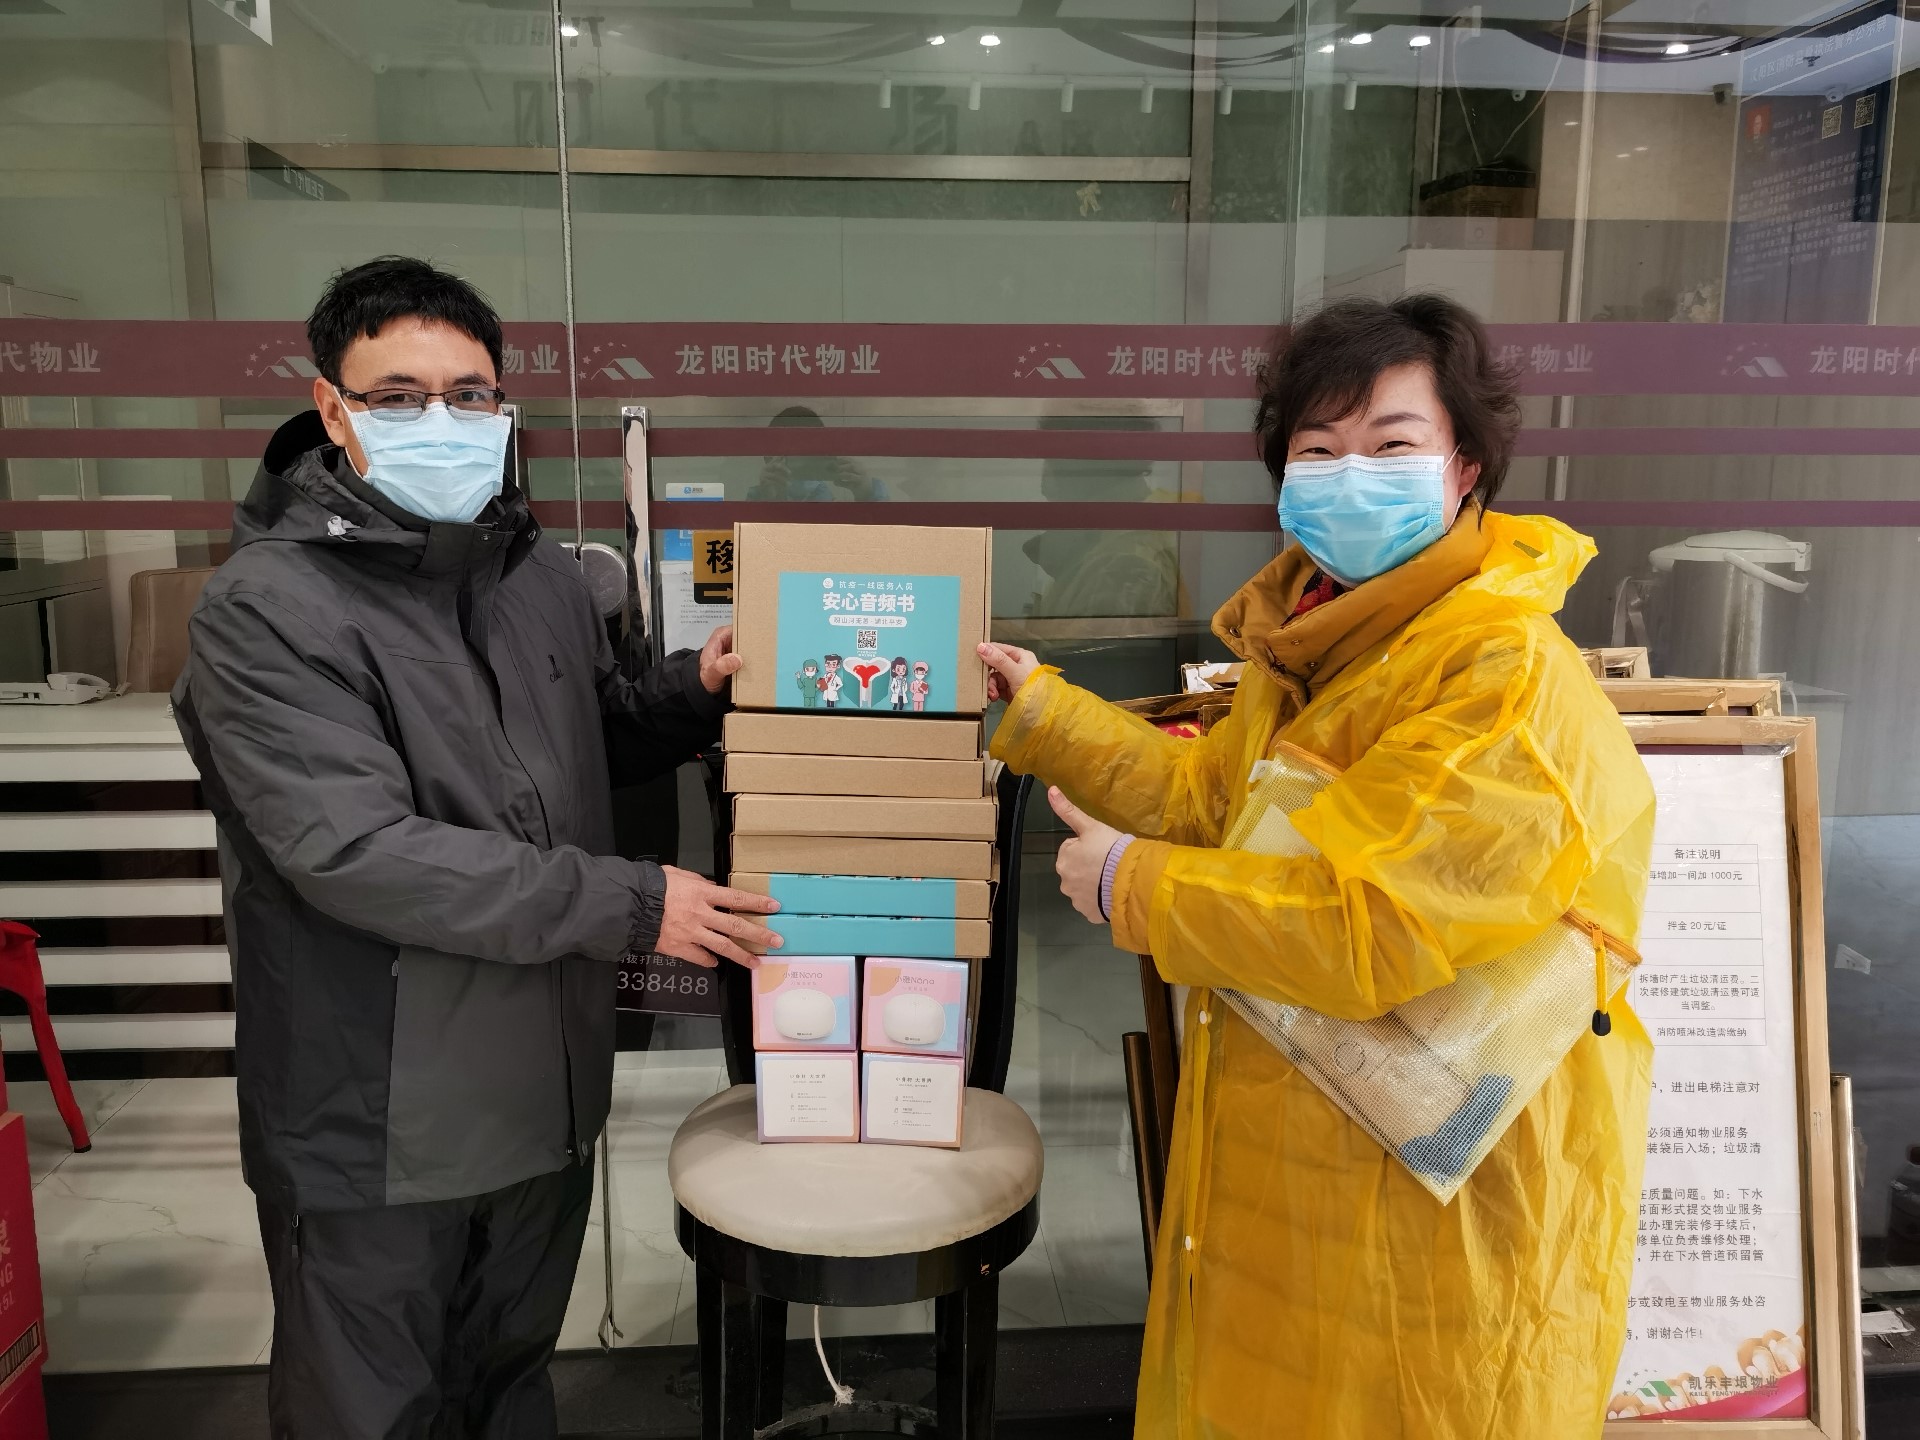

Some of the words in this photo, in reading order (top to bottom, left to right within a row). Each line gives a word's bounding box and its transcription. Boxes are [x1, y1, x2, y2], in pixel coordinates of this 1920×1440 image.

[0, 341, 101, 374] 代物业
[502, 343, 562, 376] 物业
[675, 343, 881, 375] 龙阳时代物业
[838, 580, 914, 591] 抗疫一线医务人员
[822, 591, 916, 613] 安心音频书
[1674, 847, 1722, 860] 备注说明
[616, 970, 709, 996] 338488
[1639, 986, 1760, 998] 次装修建筑垃圾清运费可适
[1656, 1026, 1748, 1038] 消防喷淋改造需缴纳
[1647, 1126, 1749, 1139] 必须通知物业服务
[1687, 1375, 1779, 1391] 凯乐丰垠物业
